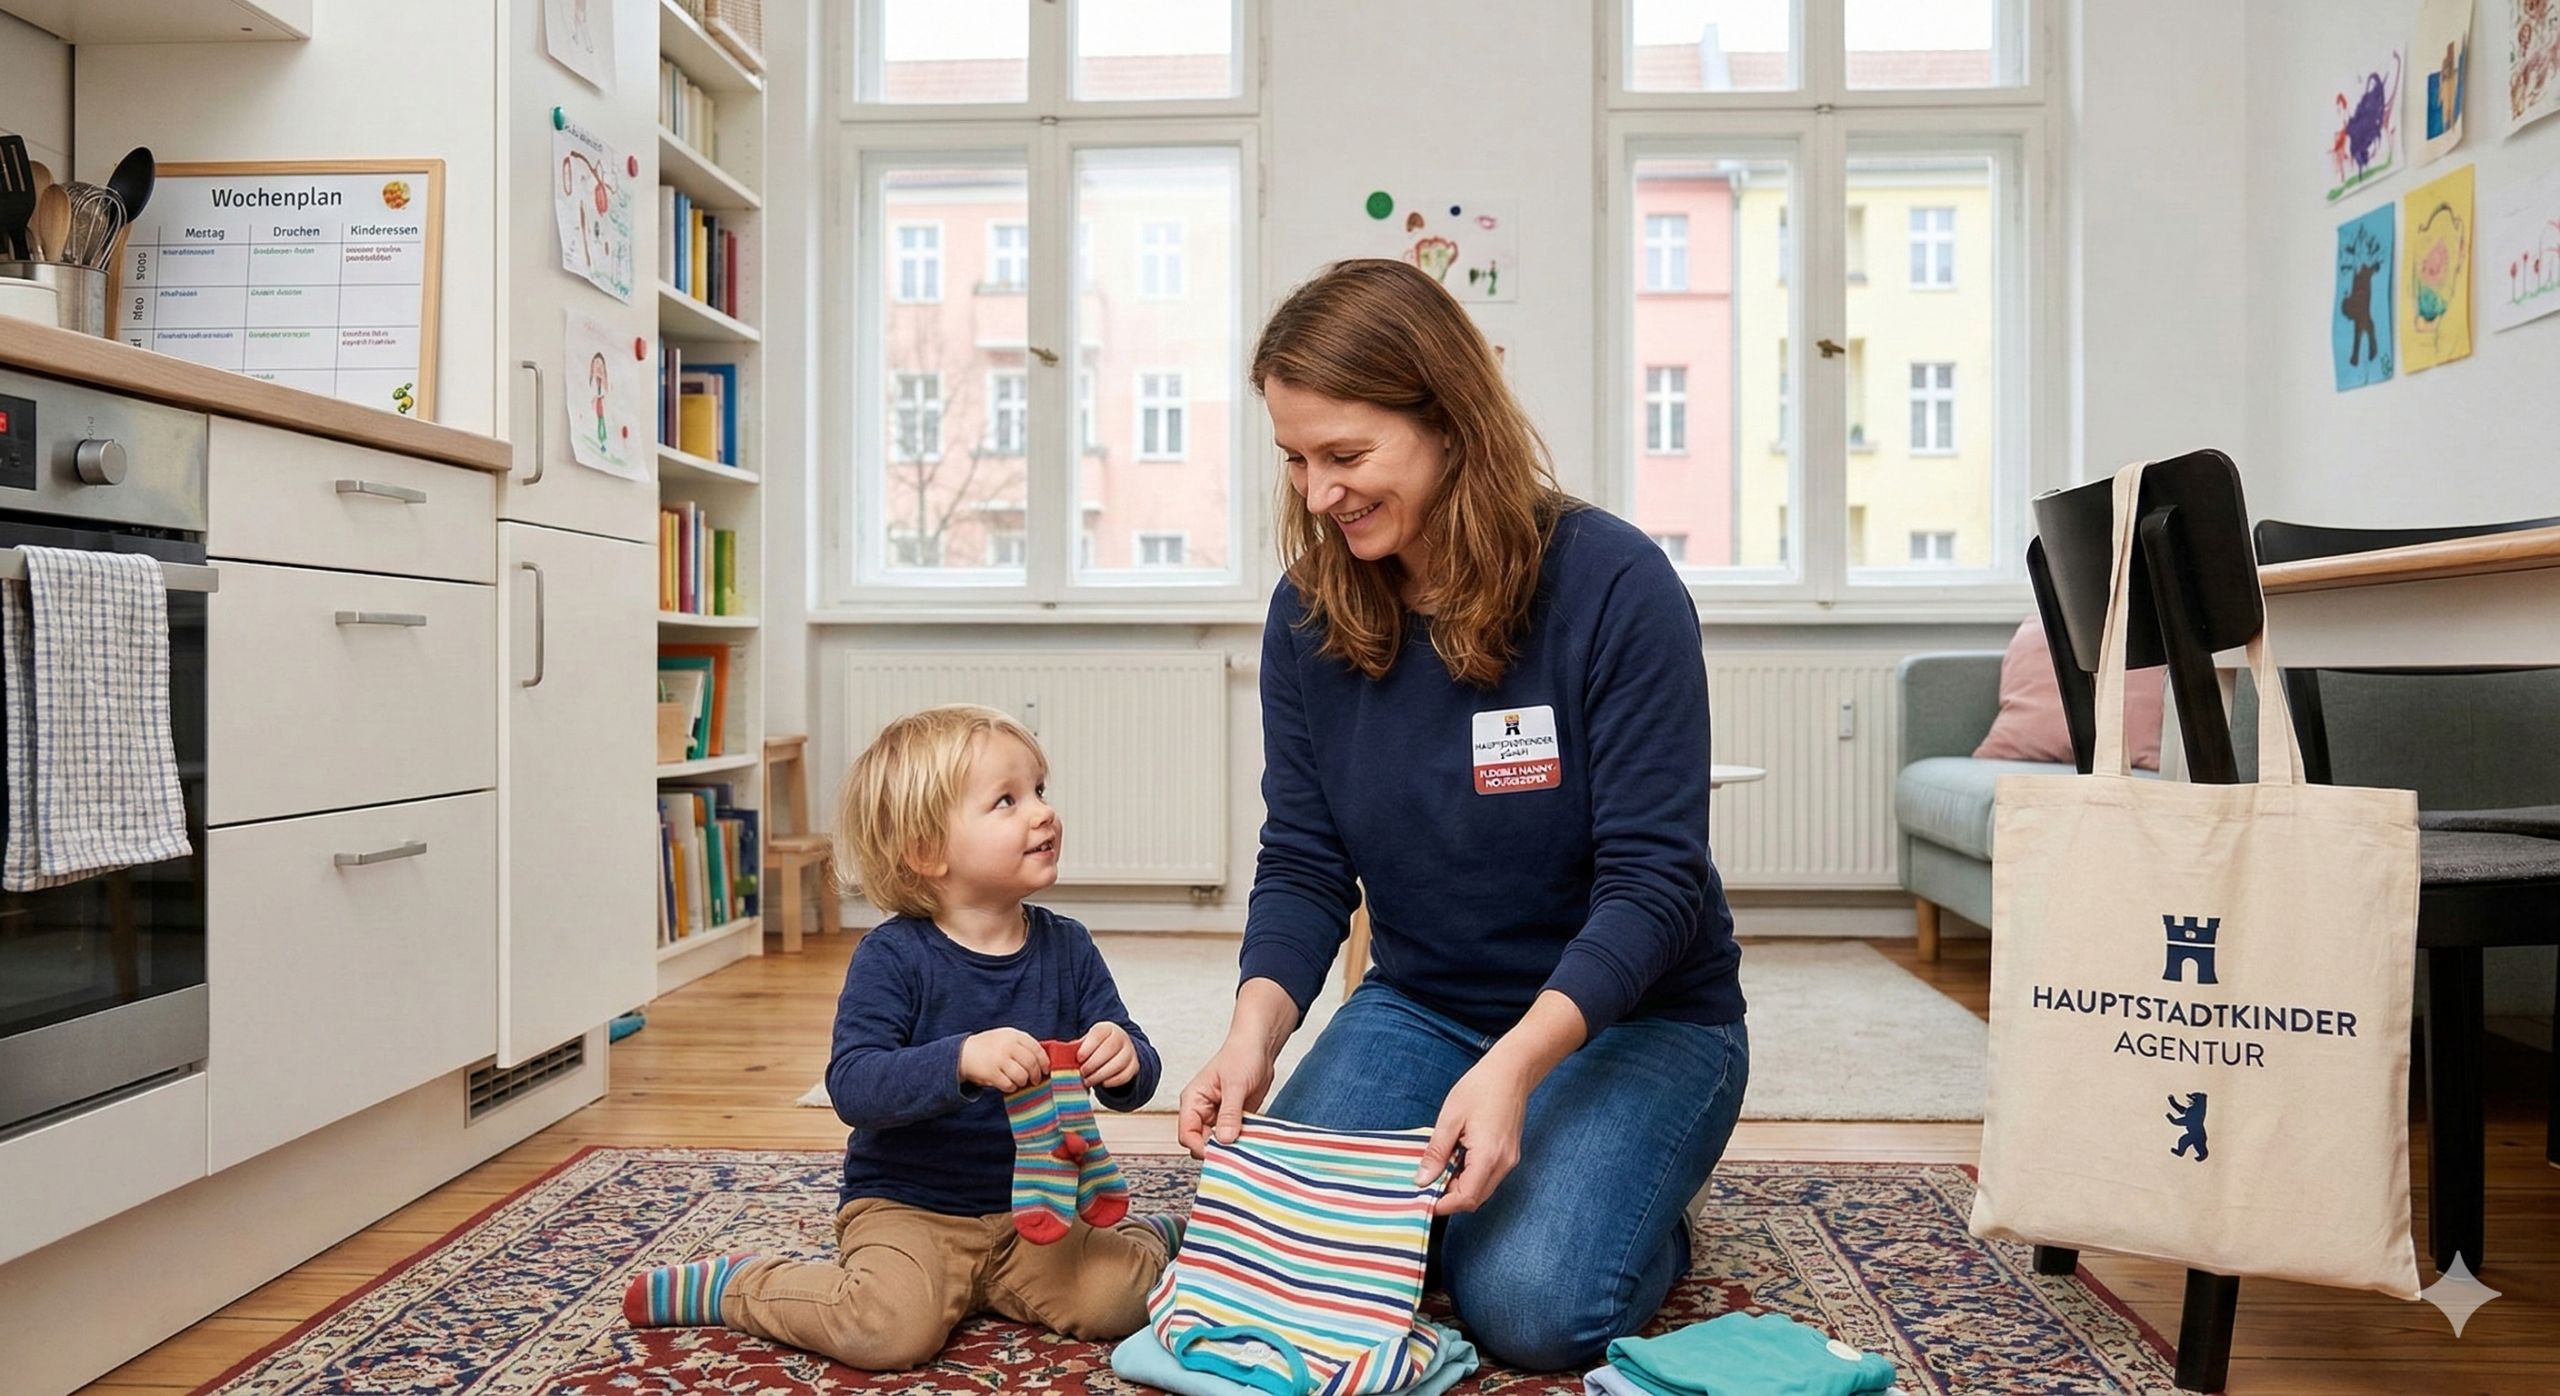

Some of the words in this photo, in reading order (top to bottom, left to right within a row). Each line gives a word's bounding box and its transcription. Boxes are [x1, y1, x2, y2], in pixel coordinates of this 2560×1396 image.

[211, 186, 343, 211] Wochenplan
[272, 226, 321, 238] Druchen
[350, 224, 418, 236] Kinderessen
[2032, 985, 2358, 1037] HAUPTSTADTKINDER
[2113, 1030, 2265, 1068] AGENTUR
